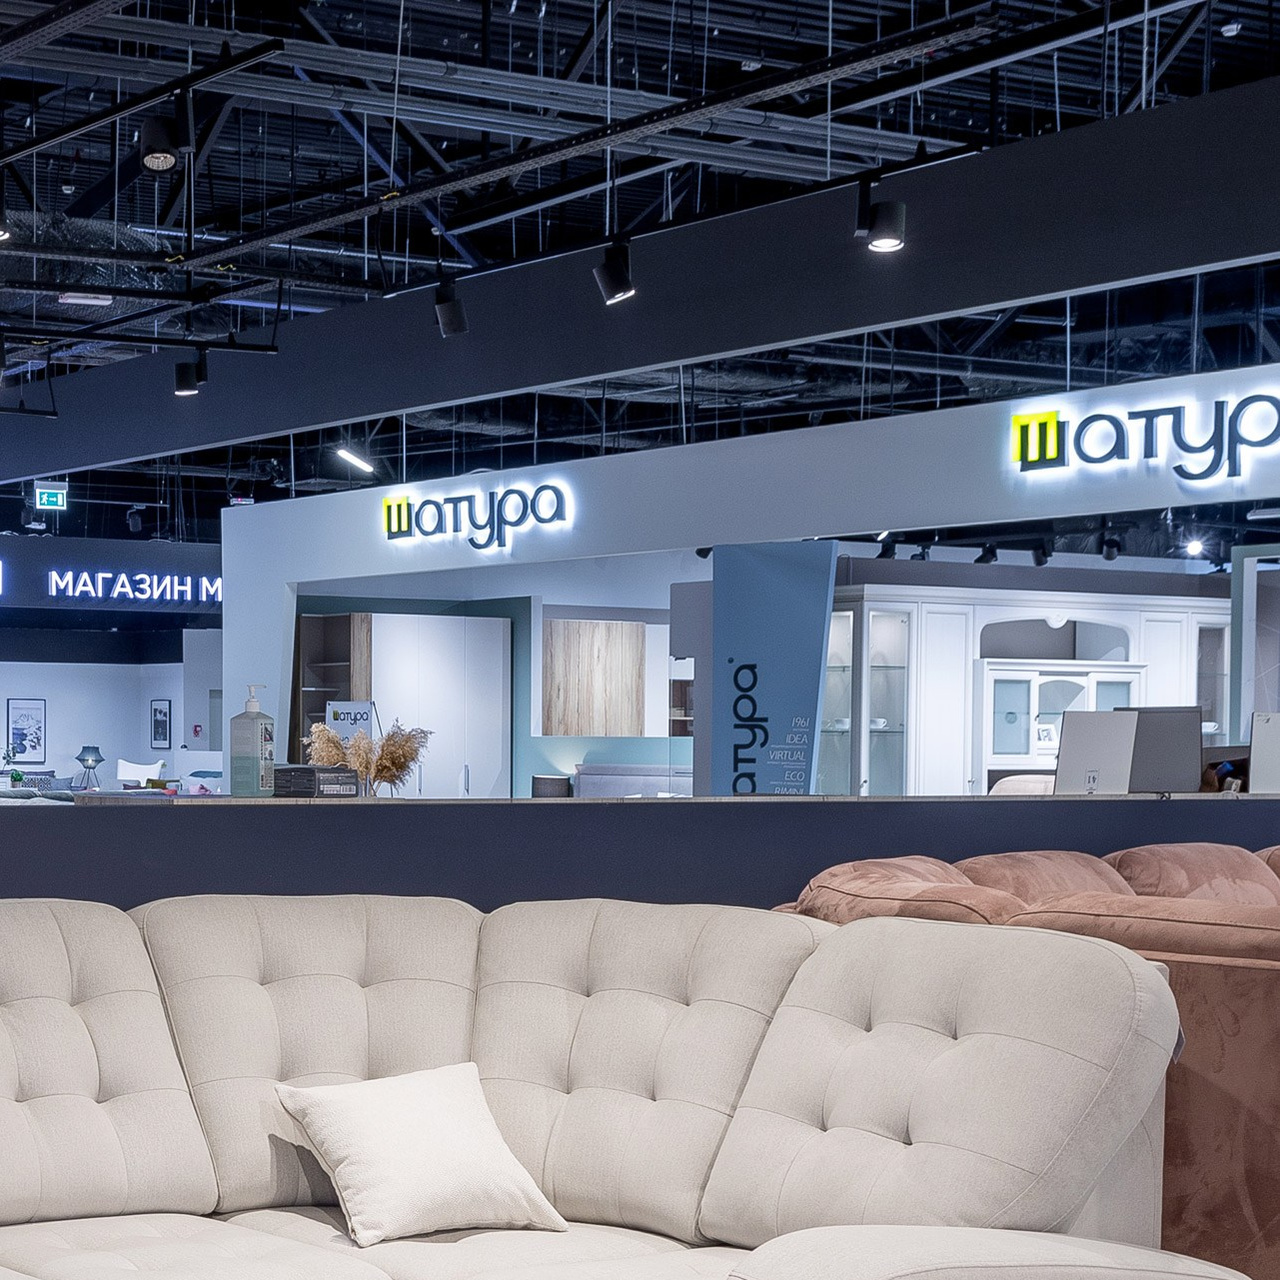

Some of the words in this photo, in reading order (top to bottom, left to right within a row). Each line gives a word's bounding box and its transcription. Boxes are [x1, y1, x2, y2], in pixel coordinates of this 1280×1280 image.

[49, 570, 192, 601] МАГАЗИН
[791, 716, 810, 728] 1961
[785, 734, 808, 744] IDEA
[769, 750, 806, 761] VIRTUAL
[784, 771, 805, 781] ECO
